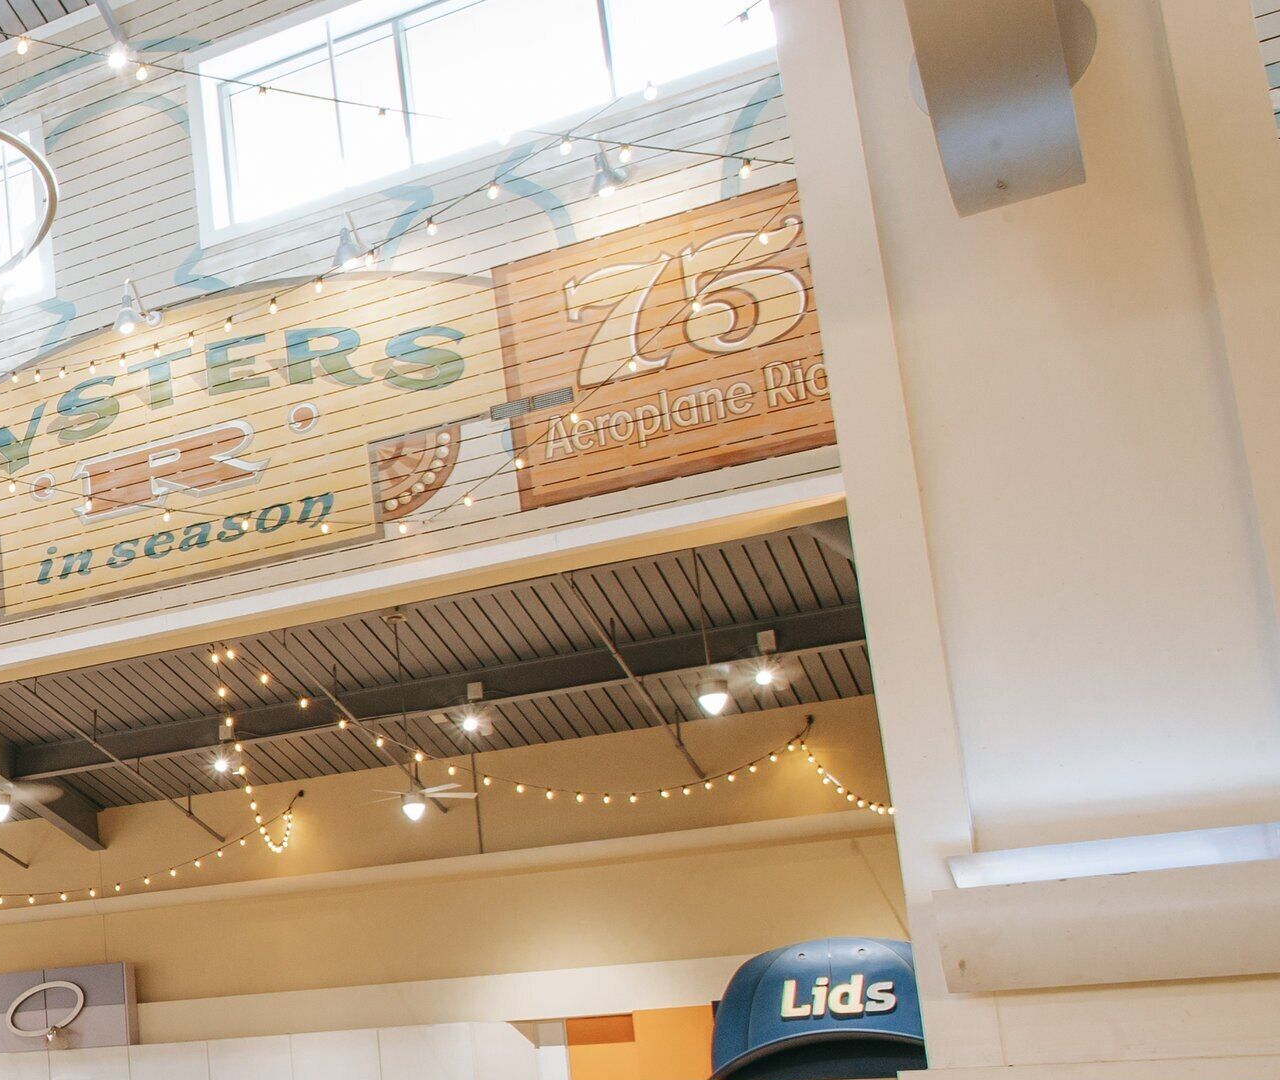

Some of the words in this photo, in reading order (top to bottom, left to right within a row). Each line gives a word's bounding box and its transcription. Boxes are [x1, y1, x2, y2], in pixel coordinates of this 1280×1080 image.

[563, 213, 809, 389] 75
[545, 381, 754, 460] Aeroplane
[37, 544, 94, 585] in
[105, 490, 337, 577] season
[780, 973, 898, 1021] Lids
